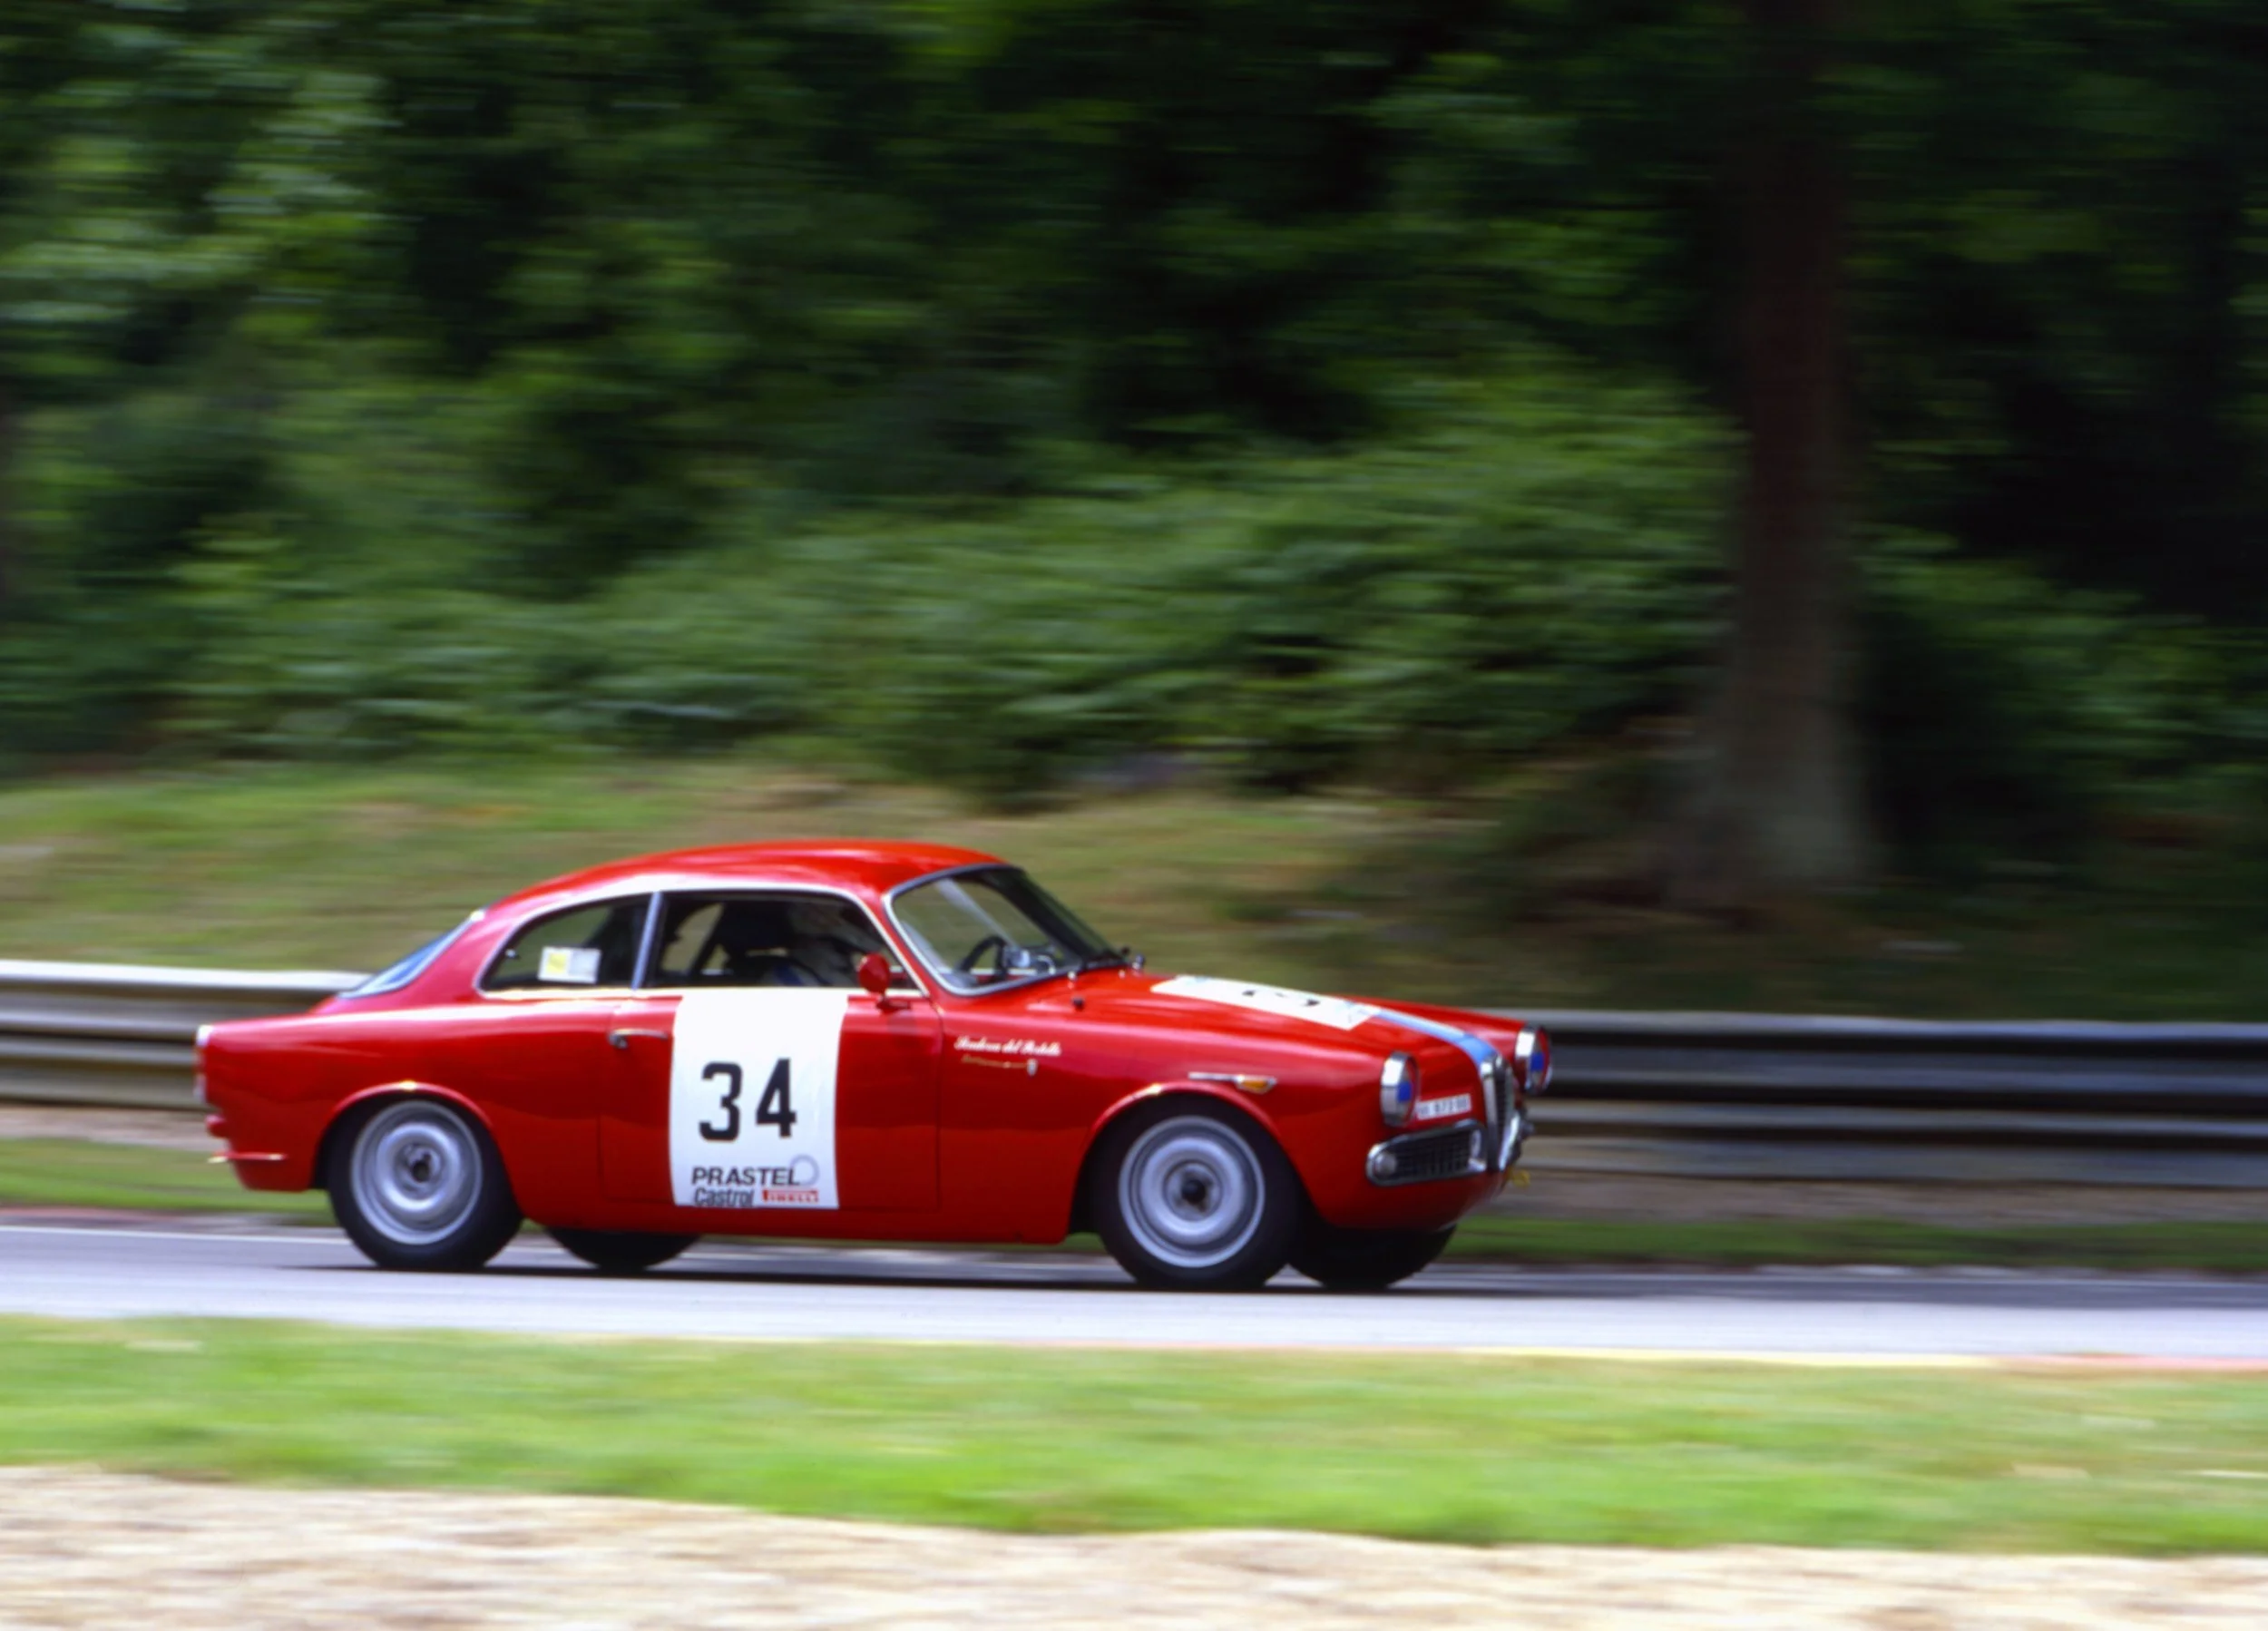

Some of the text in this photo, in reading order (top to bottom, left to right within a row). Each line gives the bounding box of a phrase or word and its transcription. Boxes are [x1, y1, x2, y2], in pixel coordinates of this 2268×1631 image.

[699, 1058, 797, 1143] 34
[691, 1167, 800, 1186] PRASTEL
[694, 1187, 754, 1207] Castrol
